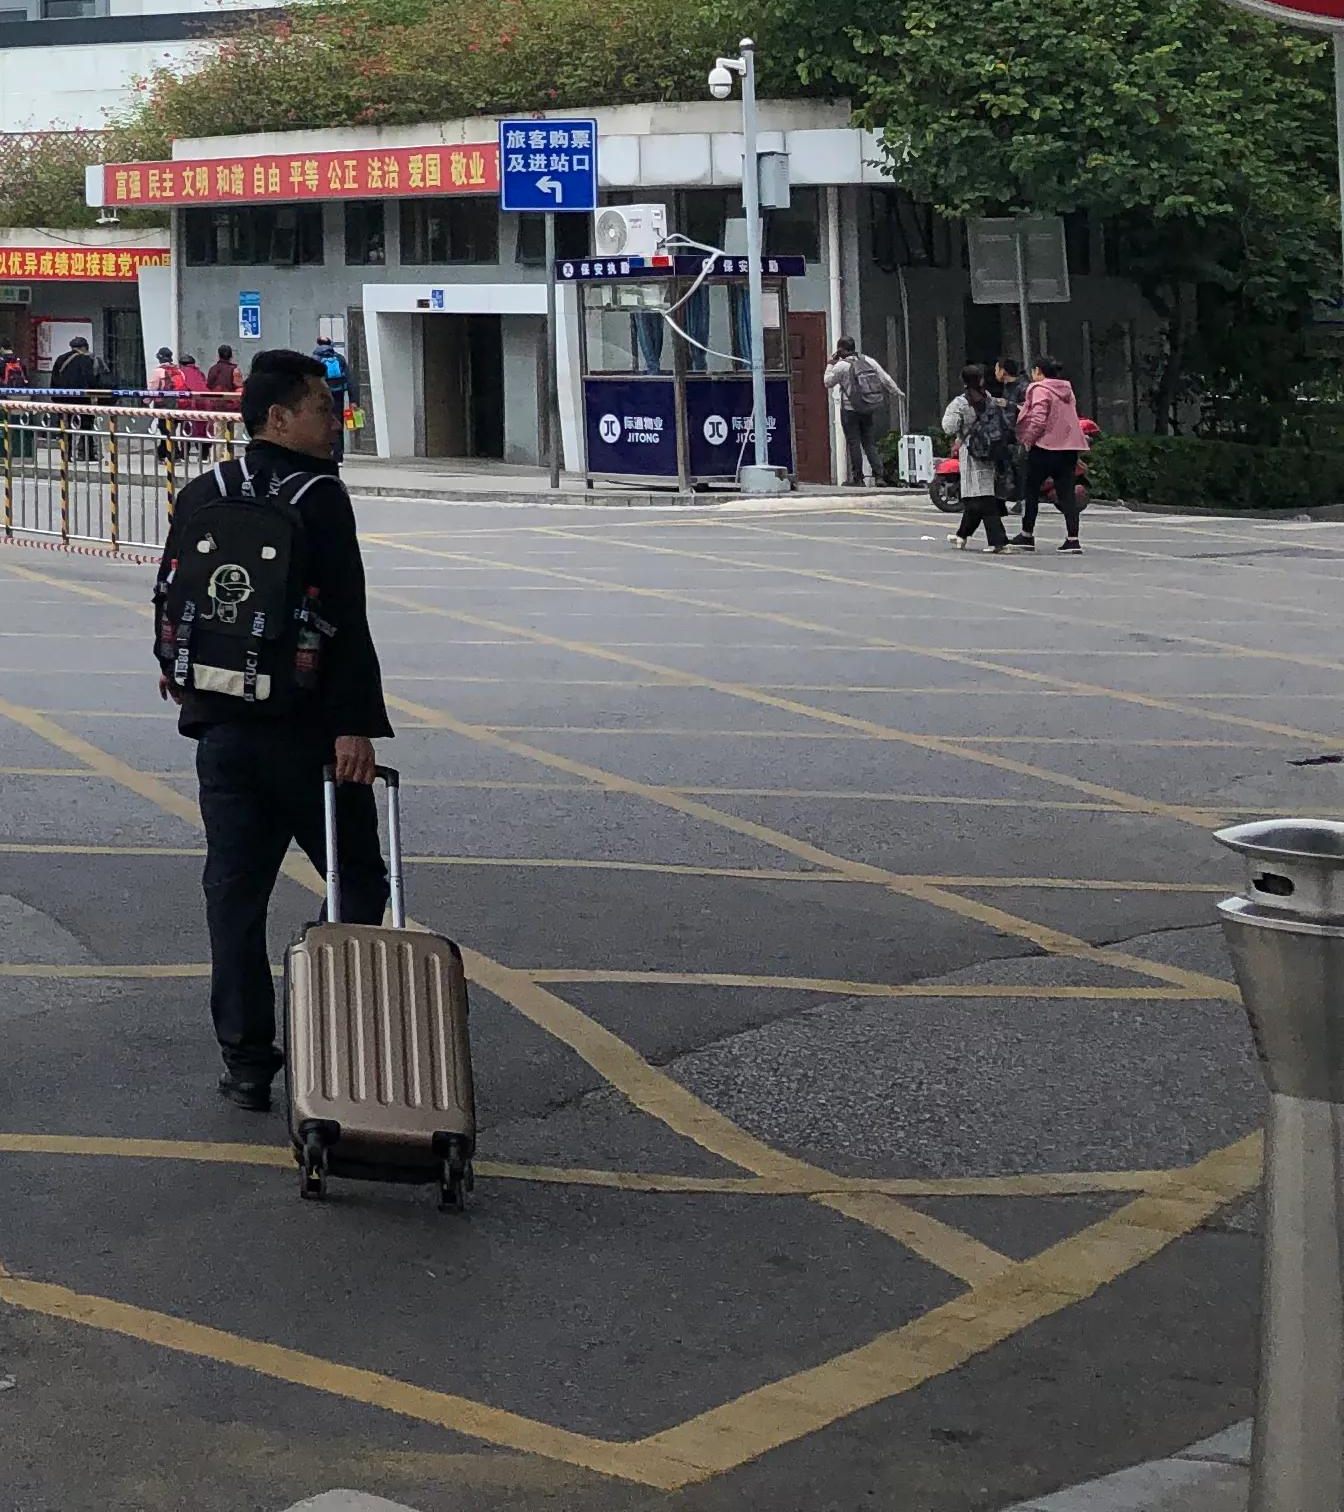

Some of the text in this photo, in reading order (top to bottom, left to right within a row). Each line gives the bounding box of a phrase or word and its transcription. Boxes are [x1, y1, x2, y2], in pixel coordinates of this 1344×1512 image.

[506, 129, 591, 149] 旅客购票
[507, 153, 590, 173] 及进站口
[116, 151, 485, 200] 富强 民主 文明 和谐 自由 平等 公正 法治 爱国 敬业
[723, 260, 779, 274] 保安勤
[732, 417, 776, 430] 际通业
[627, 432, 660, 444] JITONG
